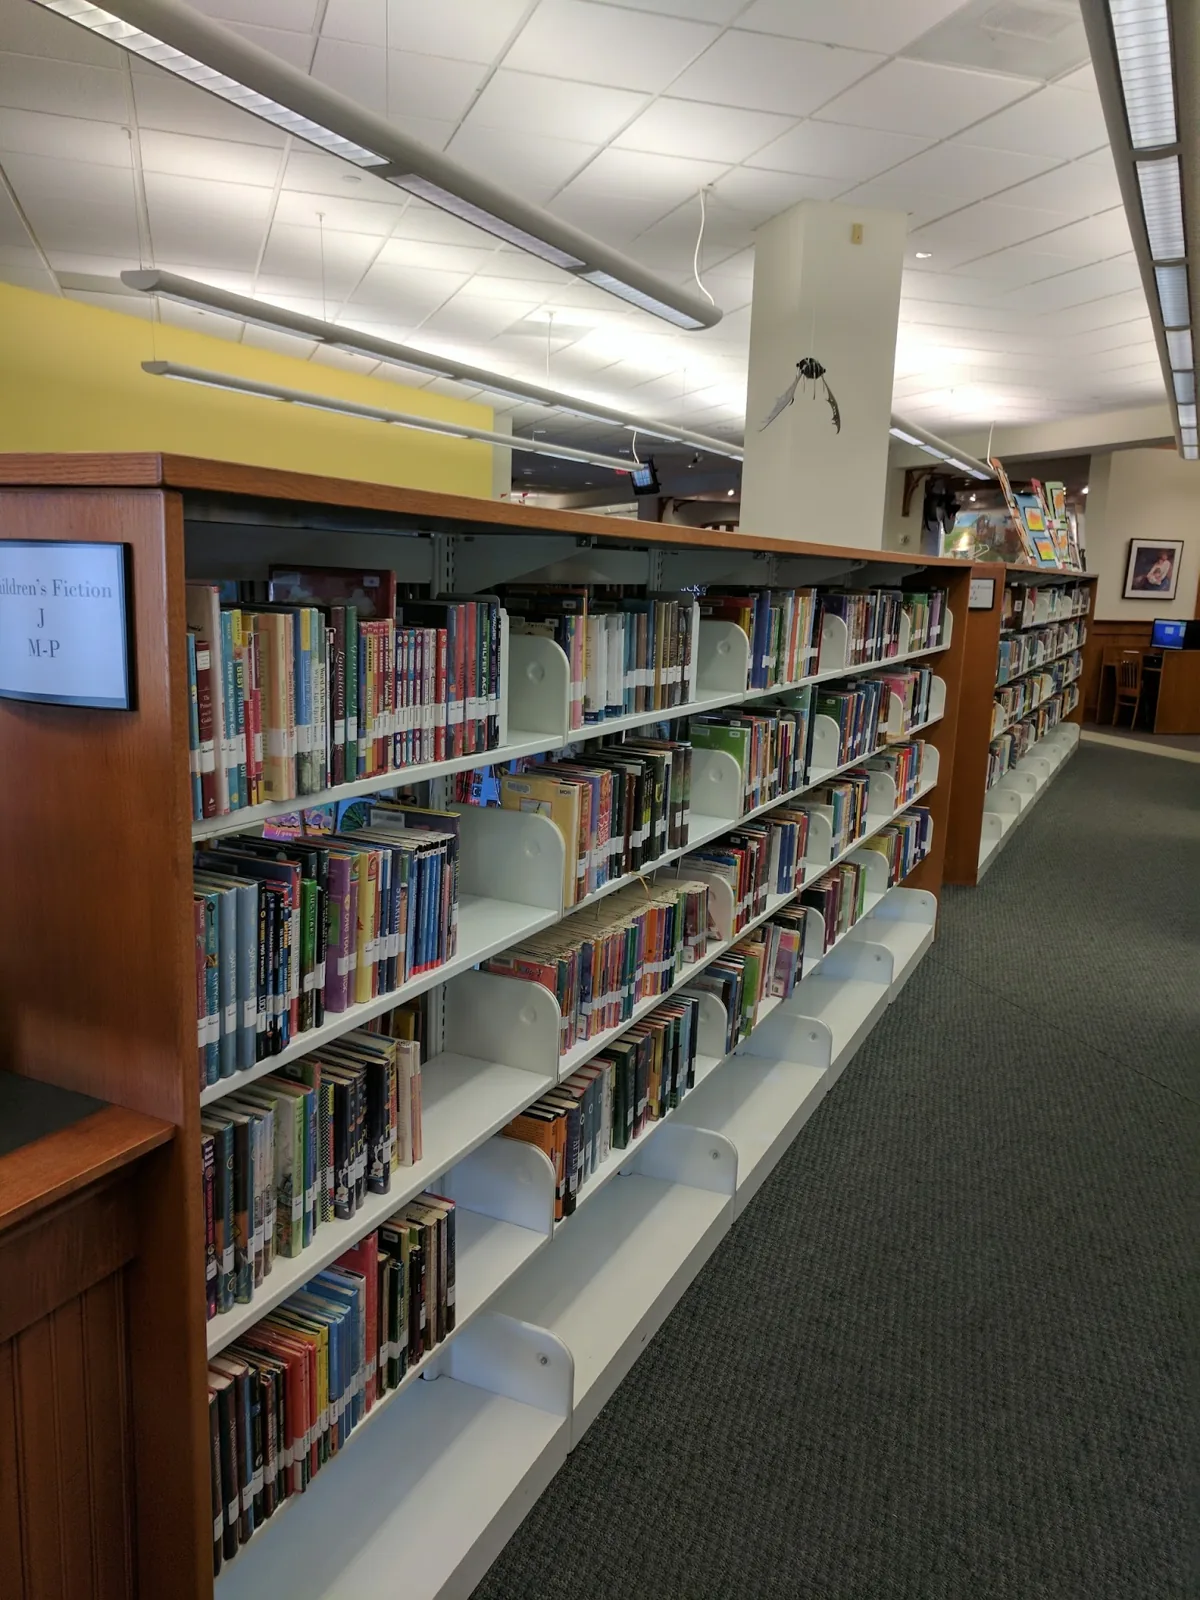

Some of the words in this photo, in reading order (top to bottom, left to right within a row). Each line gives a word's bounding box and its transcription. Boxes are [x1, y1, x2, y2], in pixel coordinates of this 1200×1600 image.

[0, 578, 47, 597] ildren's
[52, 578, 113, 599] Fiction
[37, 608, 45, 629] J
[27, 638, 61, 659] M-P
[336, 649, 346, 716] Louisiana's
